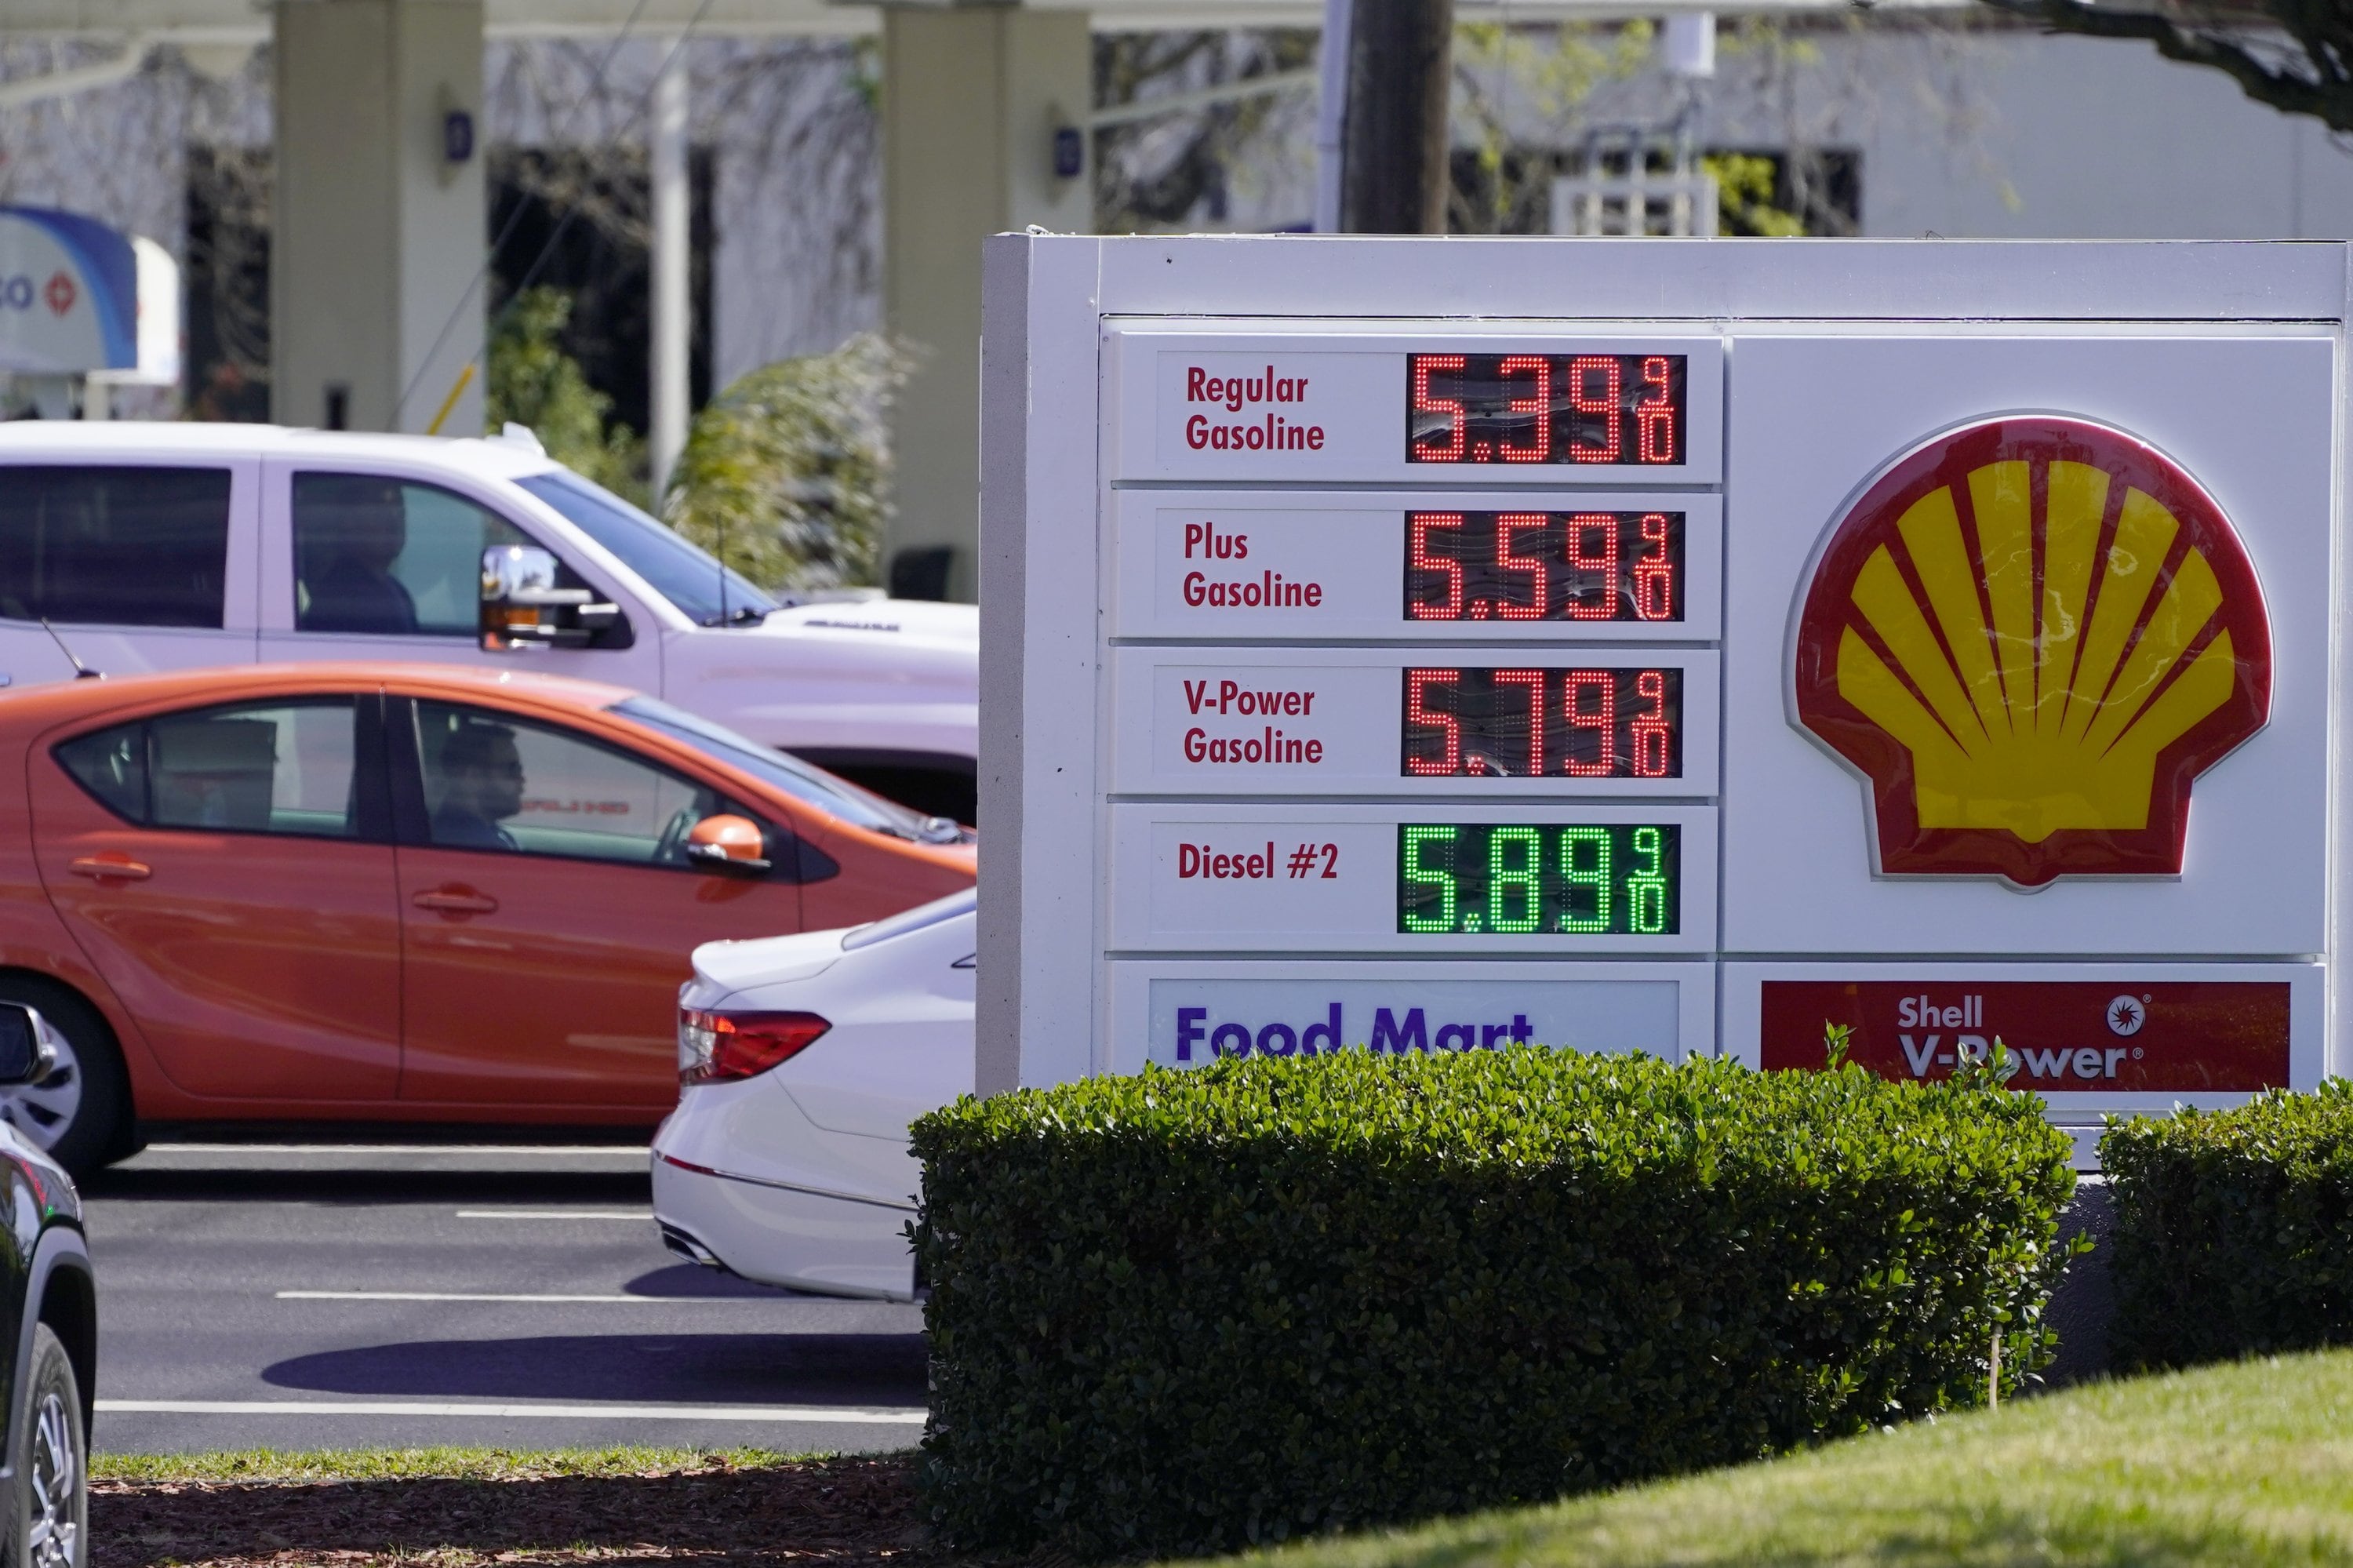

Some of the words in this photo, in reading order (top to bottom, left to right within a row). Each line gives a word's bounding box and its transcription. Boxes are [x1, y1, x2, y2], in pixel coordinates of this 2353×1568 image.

[1187, 366, 1308, 412] Regular
[1414, 357, 1620, 463] 5.39
[1186, 413, 1325, 450] Gasoline
[1184, 522, 1248, 559] Plus
[1411, 514, 1618, 620] 5.59
[1183, 570, 1322, 607] Gasoline
[1183, 680, 1315, 716] V-Power
[1408, 671, 1615, 777] 5.79
[1184, 726, 1323, 763] Gasoline
[1178, 842, 1274, 879] Diesel
[1287, 844, 1338, 879] #2
[1406, 827, 1610, 933] 5.89
[1898, 995, 1982, 1028] Shell
[1176, 1002, 1343, 1060] Food
[1369, 1007, 1533, 1054] Mart
